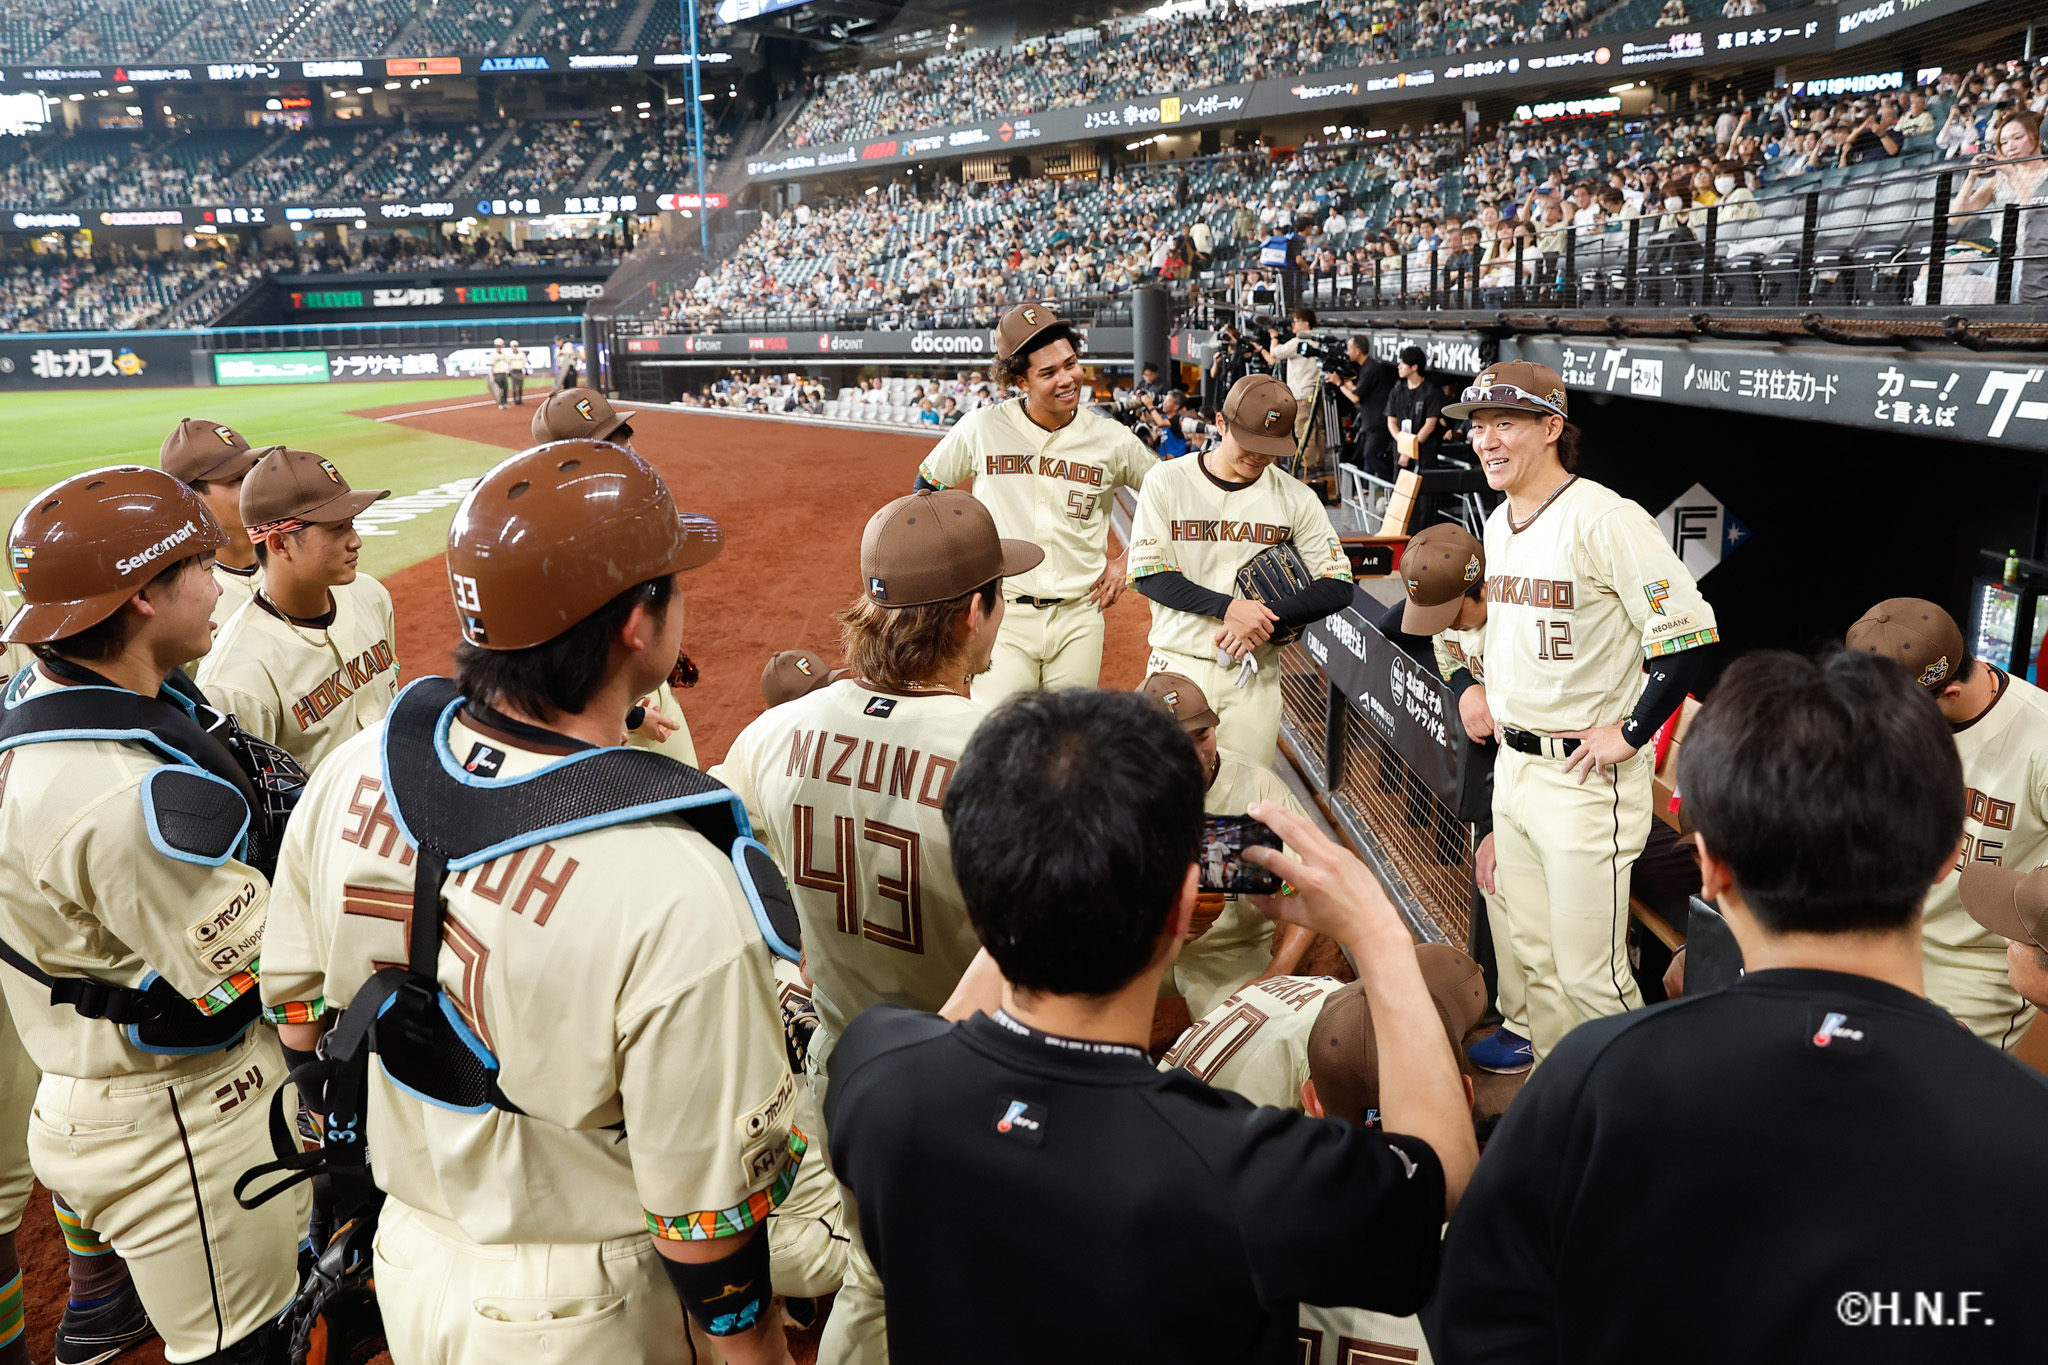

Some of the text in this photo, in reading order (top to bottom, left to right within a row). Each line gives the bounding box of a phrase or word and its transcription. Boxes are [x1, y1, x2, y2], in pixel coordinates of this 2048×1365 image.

[1716, 21, 1819, 50] 東日本フード
[911, 334, 983, 353] docomo
[30, 348, 119, 379] 北ガス
[330, 353, 439, 377] ナラサキ産業
[1561, 369, 1597, 387] と言えば
[1695, 368, 1840, 405] SMBC 三井住友カード
[1873, 400, 1960, 428] と言えば
[986, 454, 1104, 488] HOKKAIDO
[1066, 489, 1098, 521] 53
[115, 519, 198, 576] Seicomart
[1171, 519, 1292, 545] HOKKAIDO
[453, 573, 481, 612] 33
[1535, 619, 1574, 661] 12
[1651, 616, 1690, 634] NEOBANK
[1652, 670, 1666, 683] 12
[786, 729, 957, 809] MIZUNO
[793, 803, 925, 955] 43
[213, 881, 256, 932] ホクレン
[214, 1065, 264, 1114] ニトリ
